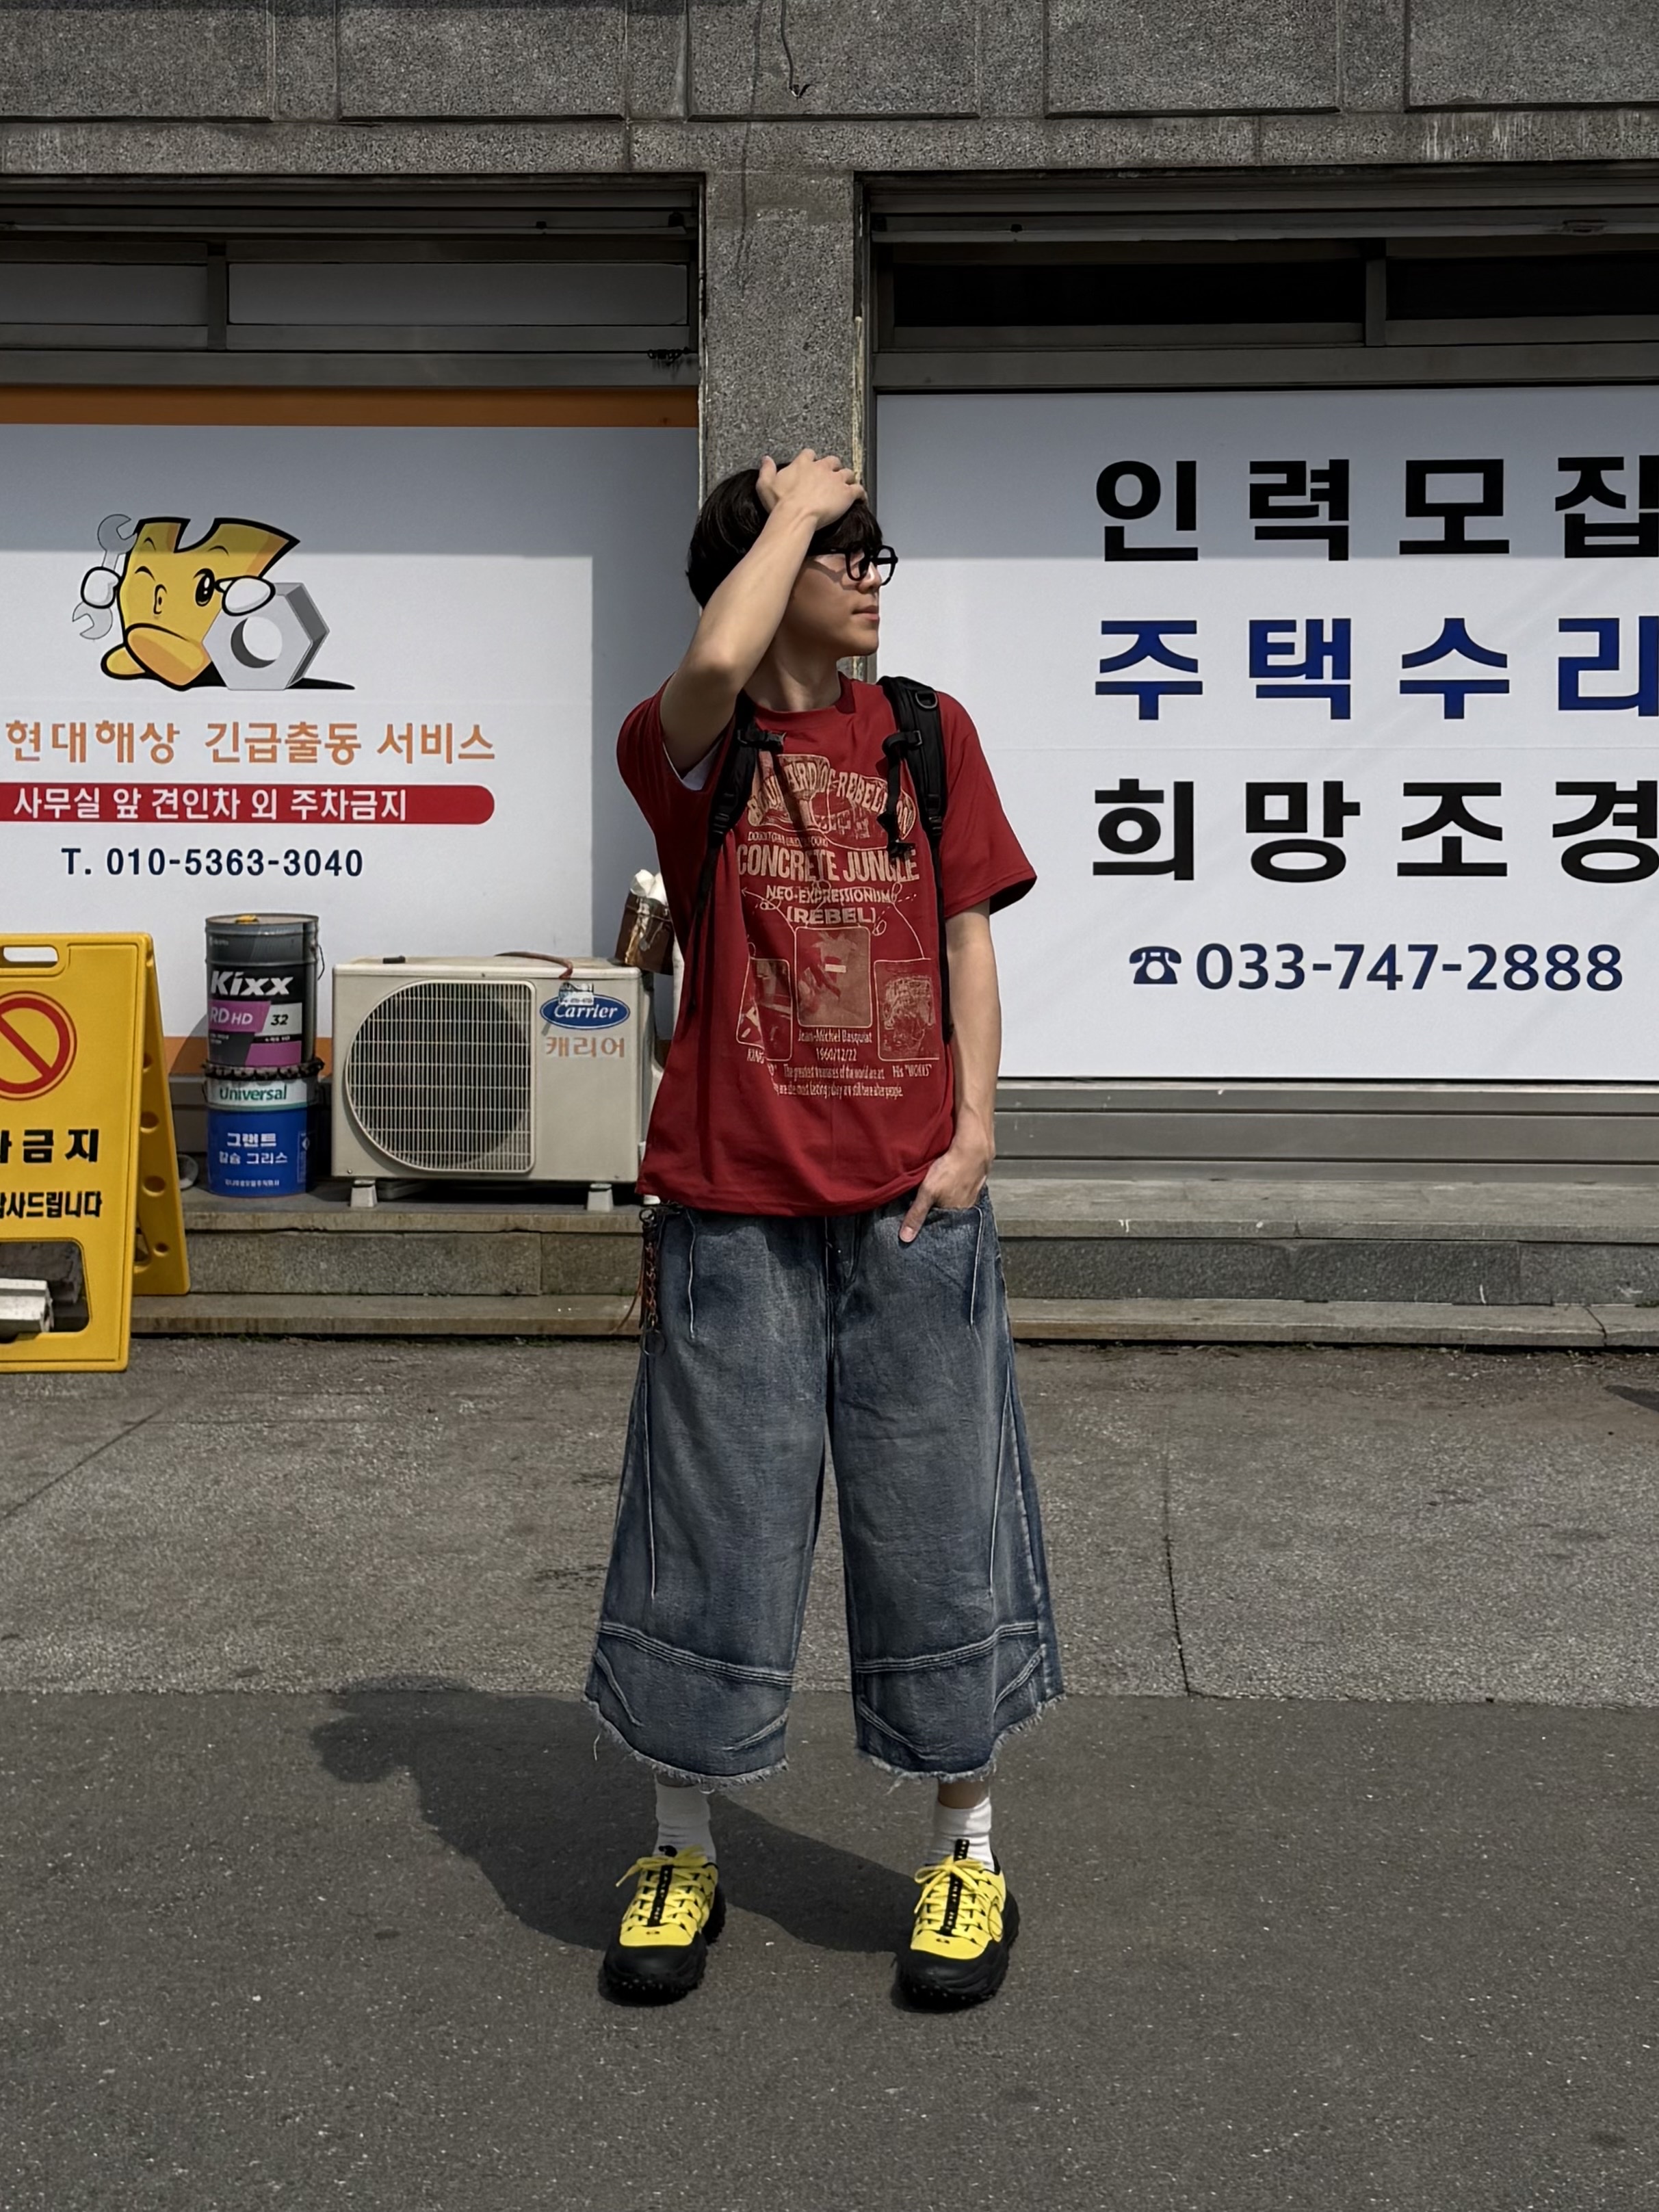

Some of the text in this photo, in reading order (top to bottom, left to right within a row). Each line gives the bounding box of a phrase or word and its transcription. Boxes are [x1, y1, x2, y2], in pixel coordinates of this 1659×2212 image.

[1096, 455, 1659, 562] 인력모집
[1095, 616, 1659, 721] 주택수리
[5, 722, 495, 765] 현대해상 긴급출동 서비스
[14, 788, 407, 822] 사무실 앞 견인차 외 주차금지
[1093, 779, 1659, 883] 희망조경
[62, 848, 364, 877] T. 010-5363-3040
[737, 844, 920, 883] CONCRETE JUNGLE
[787, 906, 876, 924] (REBEL)
[1197, 944, 1624, 992] 033-747-2888
[210, 970, 294, 996] Kixx
[231, 1012, 253, 1025] HD
[270, 1014, 289, 1026] 32
[553, 1004, 618, 1019] Carrier
[545, 1036, 625, 1058] 캐리어
[219, 1083, 287, 1102] Universal
[246, 1151, 288, 1164] 그리스
